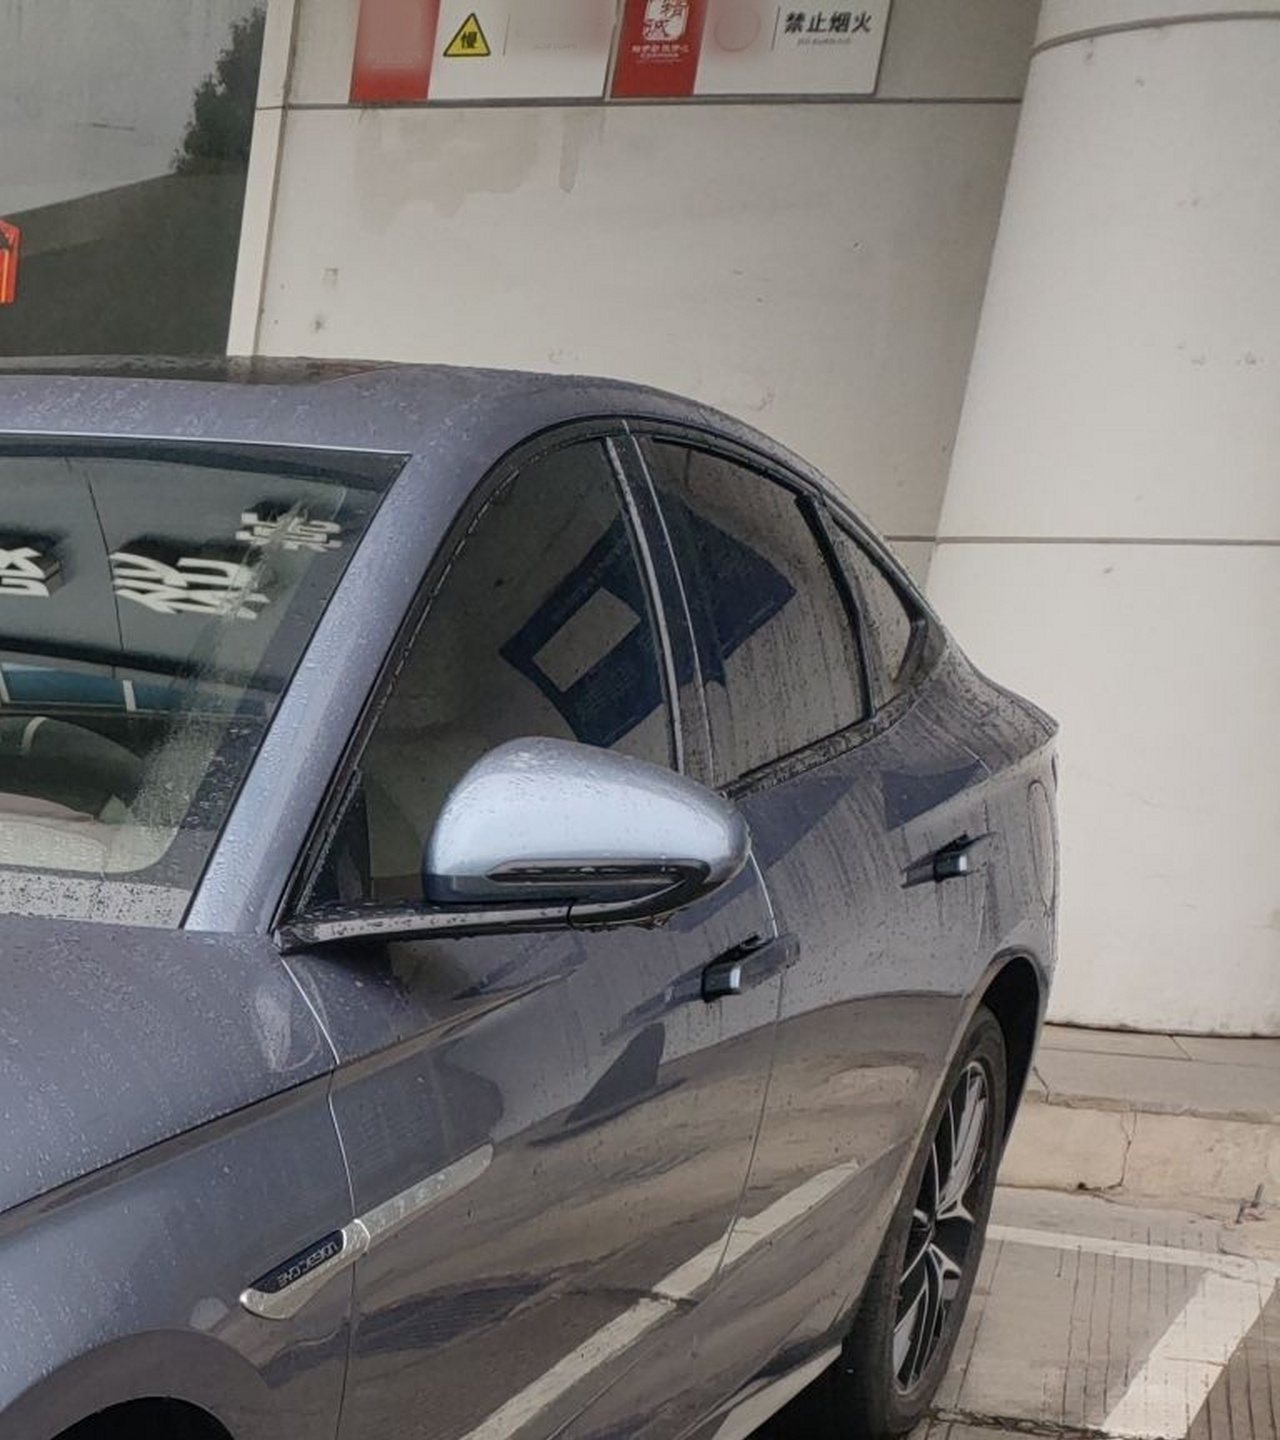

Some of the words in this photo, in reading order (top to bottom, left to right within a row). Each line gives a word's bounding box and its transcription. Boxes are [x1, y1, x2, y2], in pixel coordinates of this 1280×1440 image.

[785, 10, 872, 34] 禁止烟火
[276, 1265, 301, 1286] BYD
